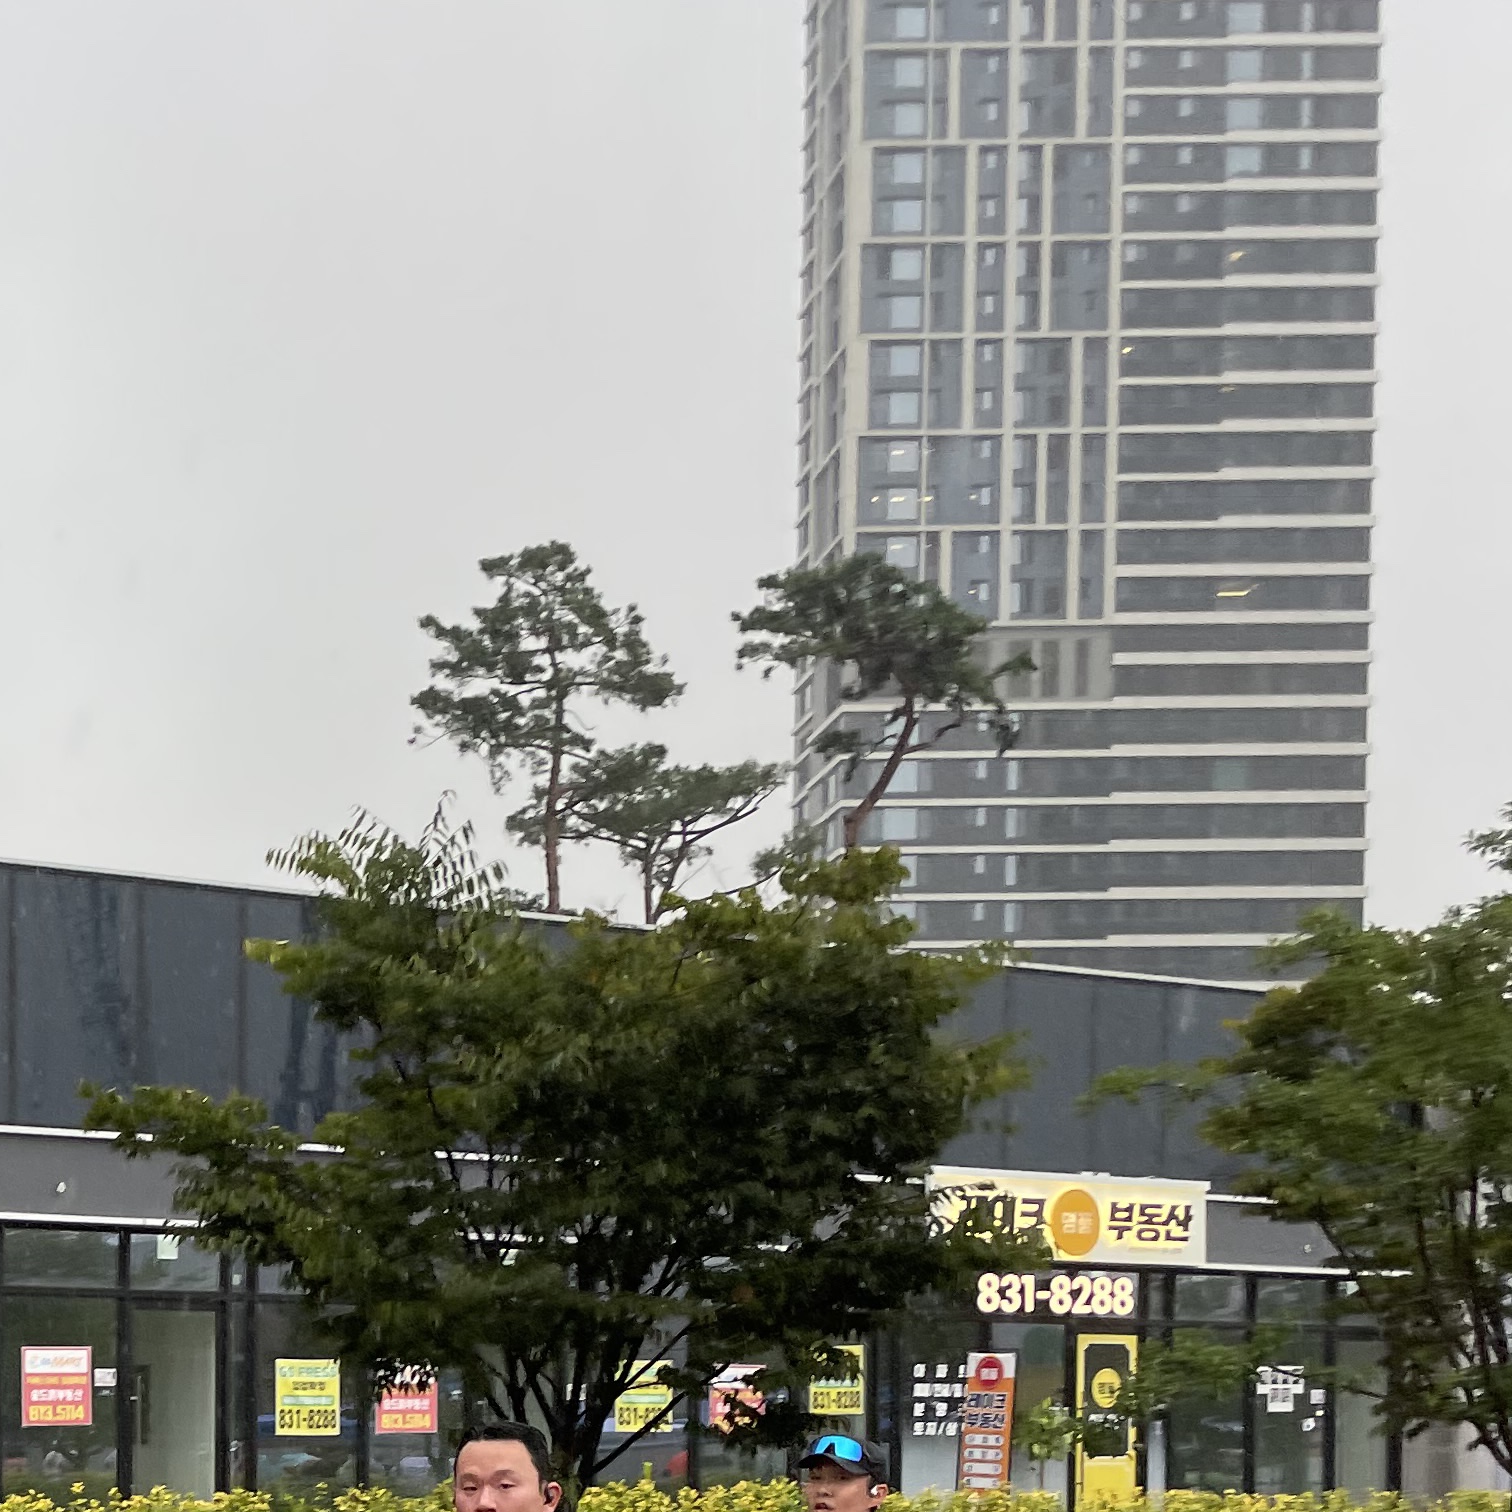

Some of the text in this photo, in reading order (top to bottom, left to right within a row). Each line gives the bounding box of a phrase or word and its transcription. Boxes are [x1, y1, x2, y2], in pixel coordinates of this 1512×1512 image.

[1107, 1201, 1192, 1242] 부동산
[977, 1272, 1135, 1316] 831-8288
[279, 1409, 336, 1429] 831-8288
[966, 1412, 1006, 1429] 부동산
